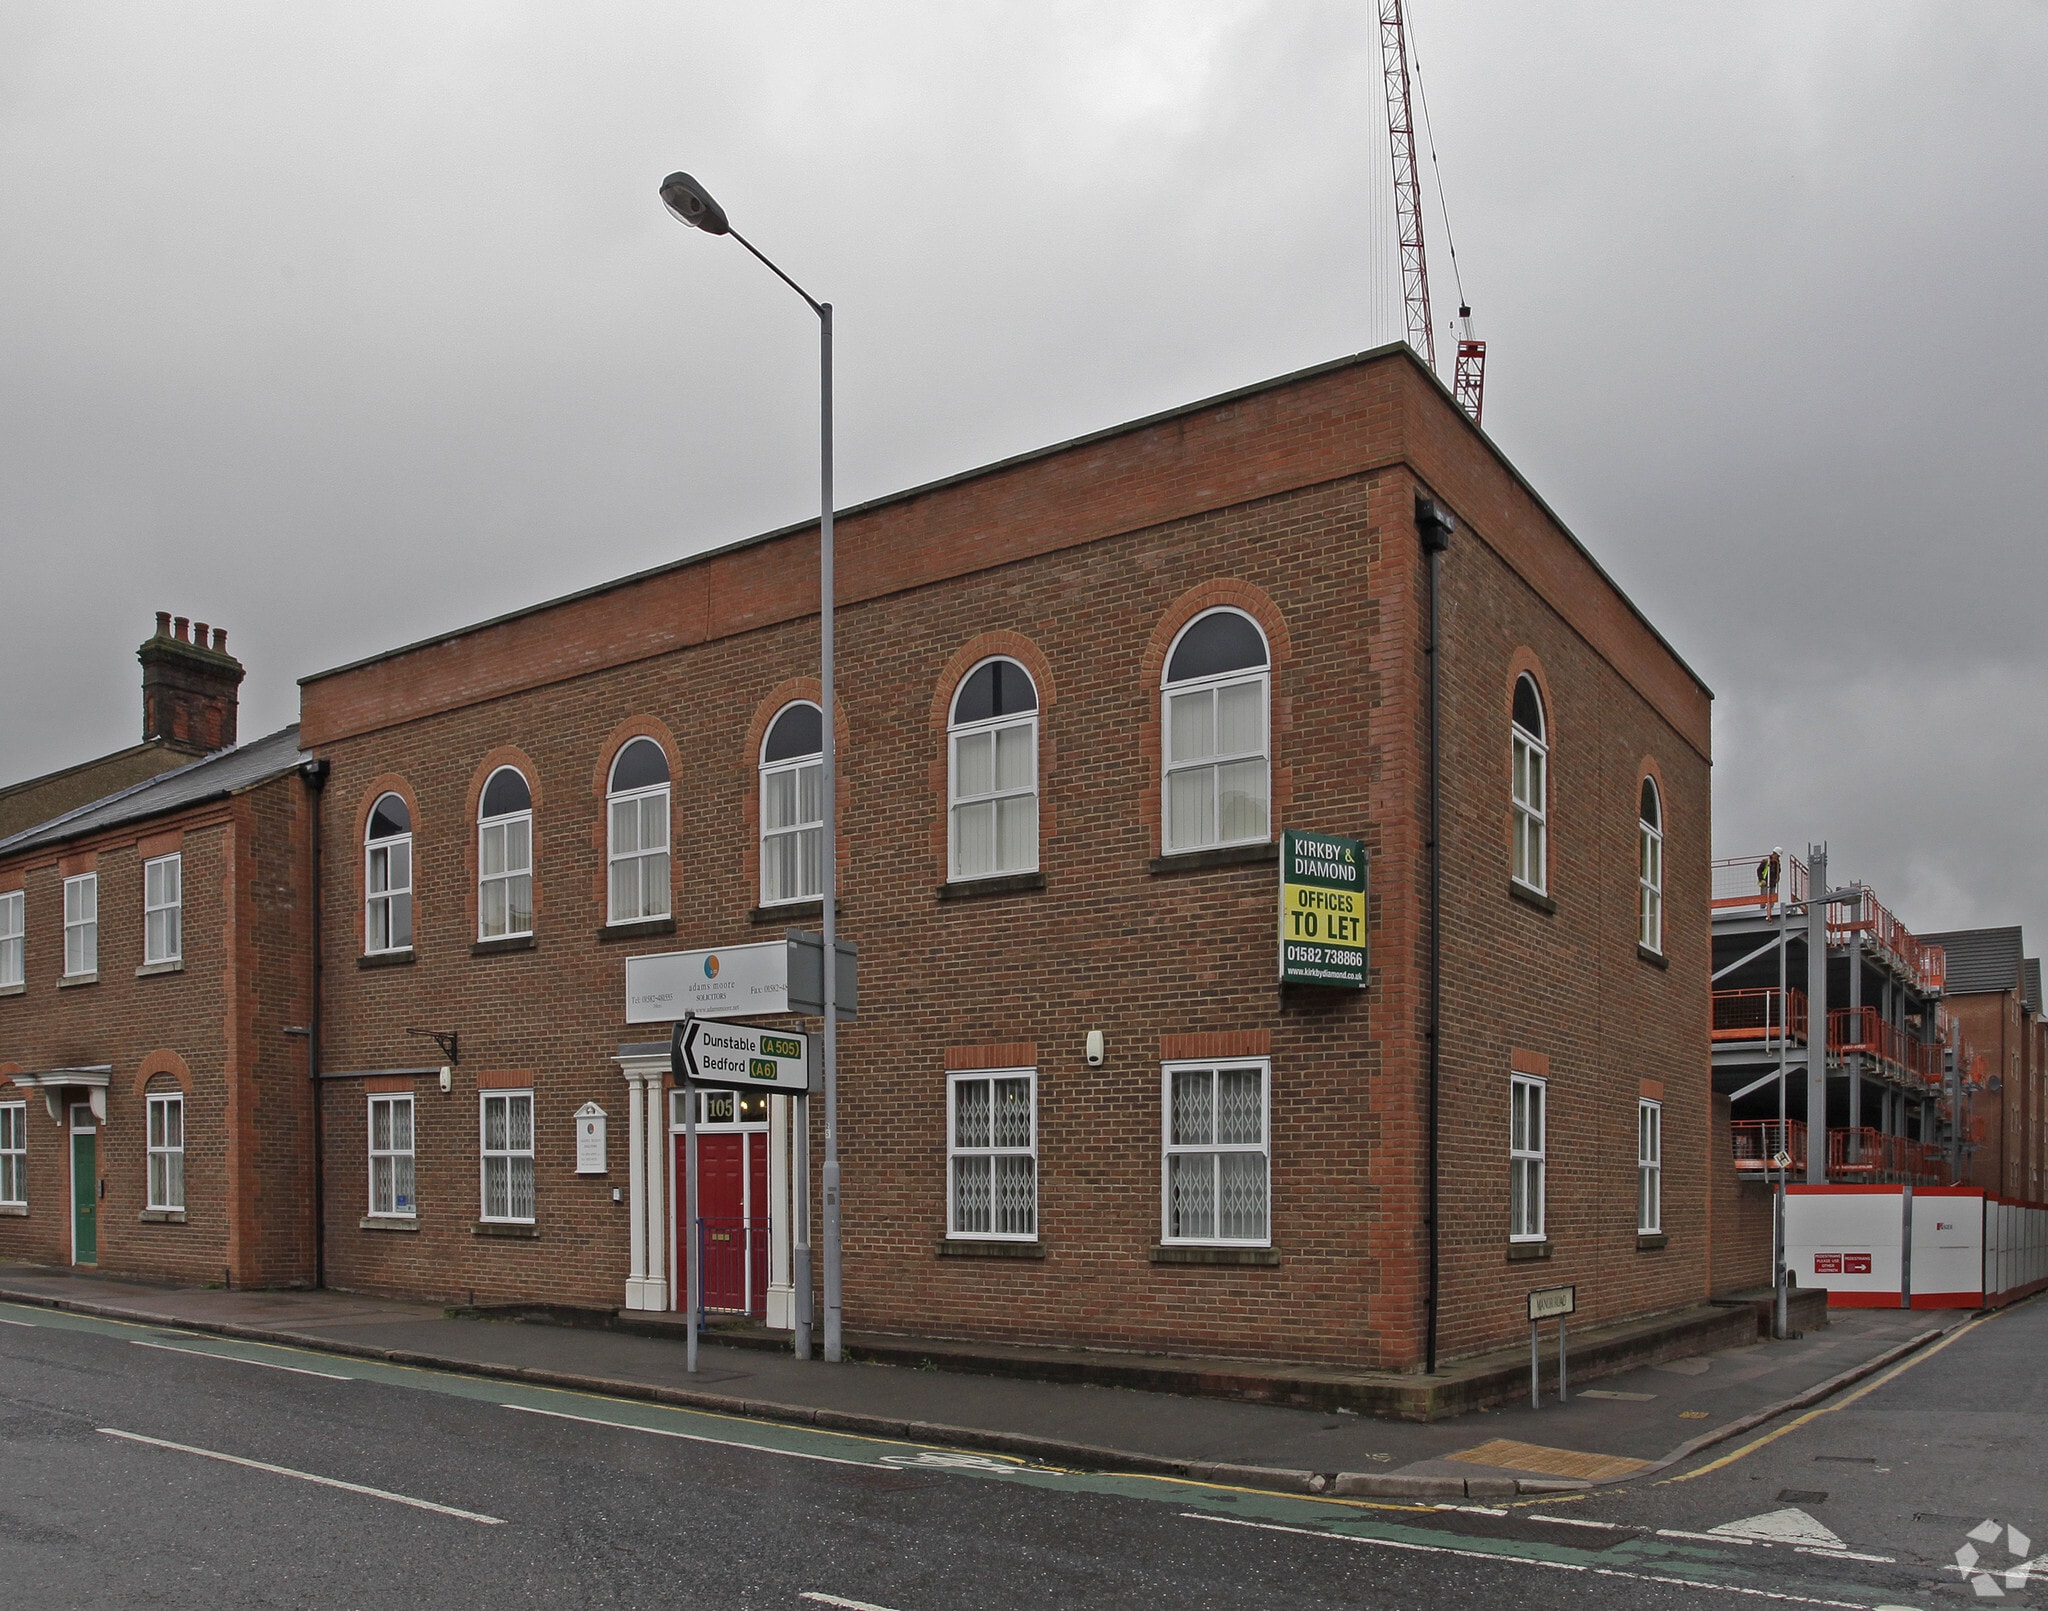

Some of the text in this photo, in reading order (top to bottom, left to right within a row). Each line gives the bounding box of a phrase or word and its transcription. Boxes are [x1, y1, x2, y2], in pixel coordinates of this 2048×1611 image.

[1295, 838, 1355, 863] KIRKBY &
[1295, 858, 1356, 882] DIAMOND
[1298, 889, 1353, 913] OFFICES
[1291, 910, 1360, 942] TO LET
[1287, 945, 1363, 967] 01582 738866
[1287, 967, 1363, 981] www.kirkbydiamond.co.uk
[688, 981, 736, 991] adams moore
[696, 992, 727, 1001] SOLICITORS
[703, 1032, 756, 1052] Dunstable
[703, 1055, 746, 1073] Bedford
[709, 1098, 733, 1117] 105
